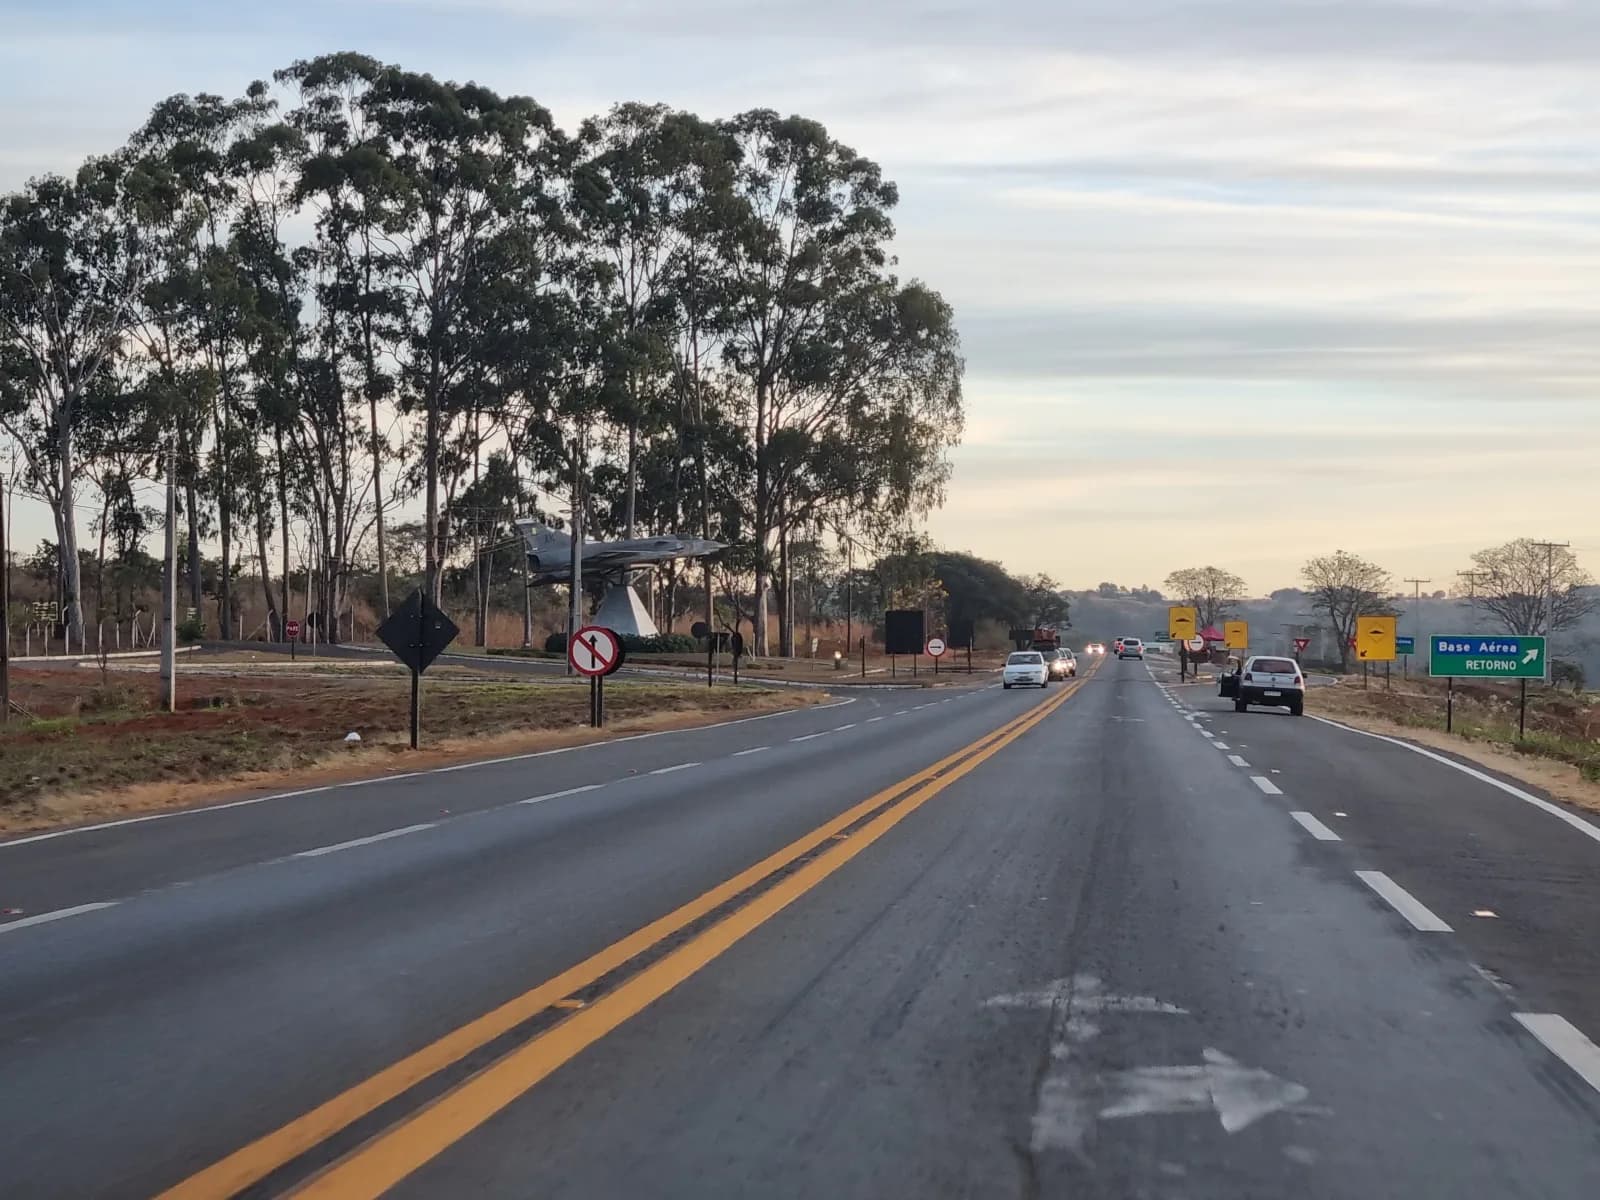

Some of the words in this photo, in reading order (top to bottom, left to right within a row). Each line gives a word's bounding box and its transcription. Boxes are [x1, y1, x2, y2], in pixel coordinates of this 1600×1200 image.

[1438, 641, 1471, 652] Base
[1479, 641, 1517, 653] Aérea
[1466, 660, 1517, 670] RETORNO
